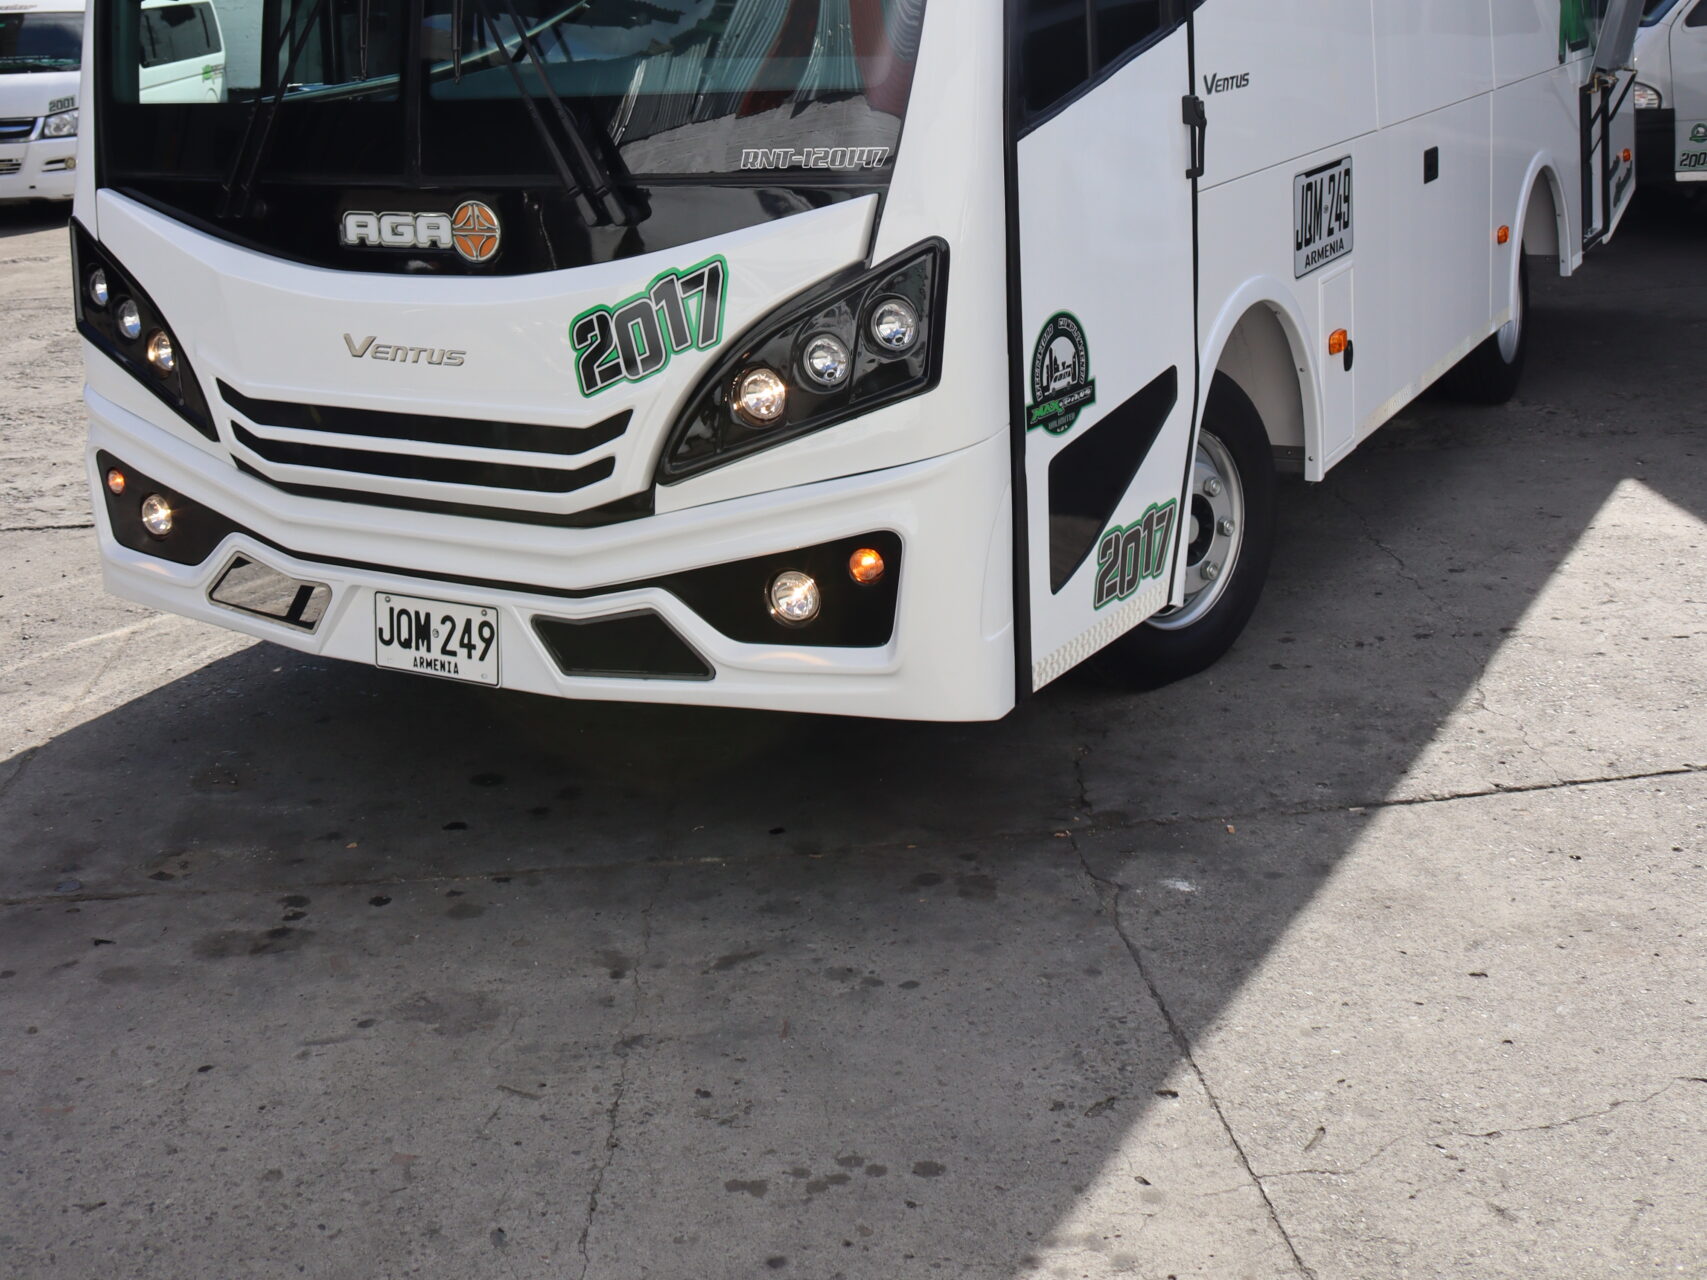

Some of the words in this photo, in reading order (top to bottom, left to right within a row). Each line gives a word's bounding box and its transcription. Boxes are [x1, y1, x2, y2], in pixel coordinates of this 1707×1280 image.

[49, 96, 76, 113] 2001
[740, 146, 889, 170] RNT-120147
[1296, 177, 1323, 252] JQM
[1327, 167, 1351, 238] 249
[342, 211, 452, 248] AGA
[1304, 237, 1345, 270] ARMENIA
[570, 256, 727, 396] 2017
[1095, 502, 1175, 608] 2017
[378, 607, 431, 653] JQM
[440, 615, 495, 661] 249
[413, 656, 459, 675] ARMENIA
